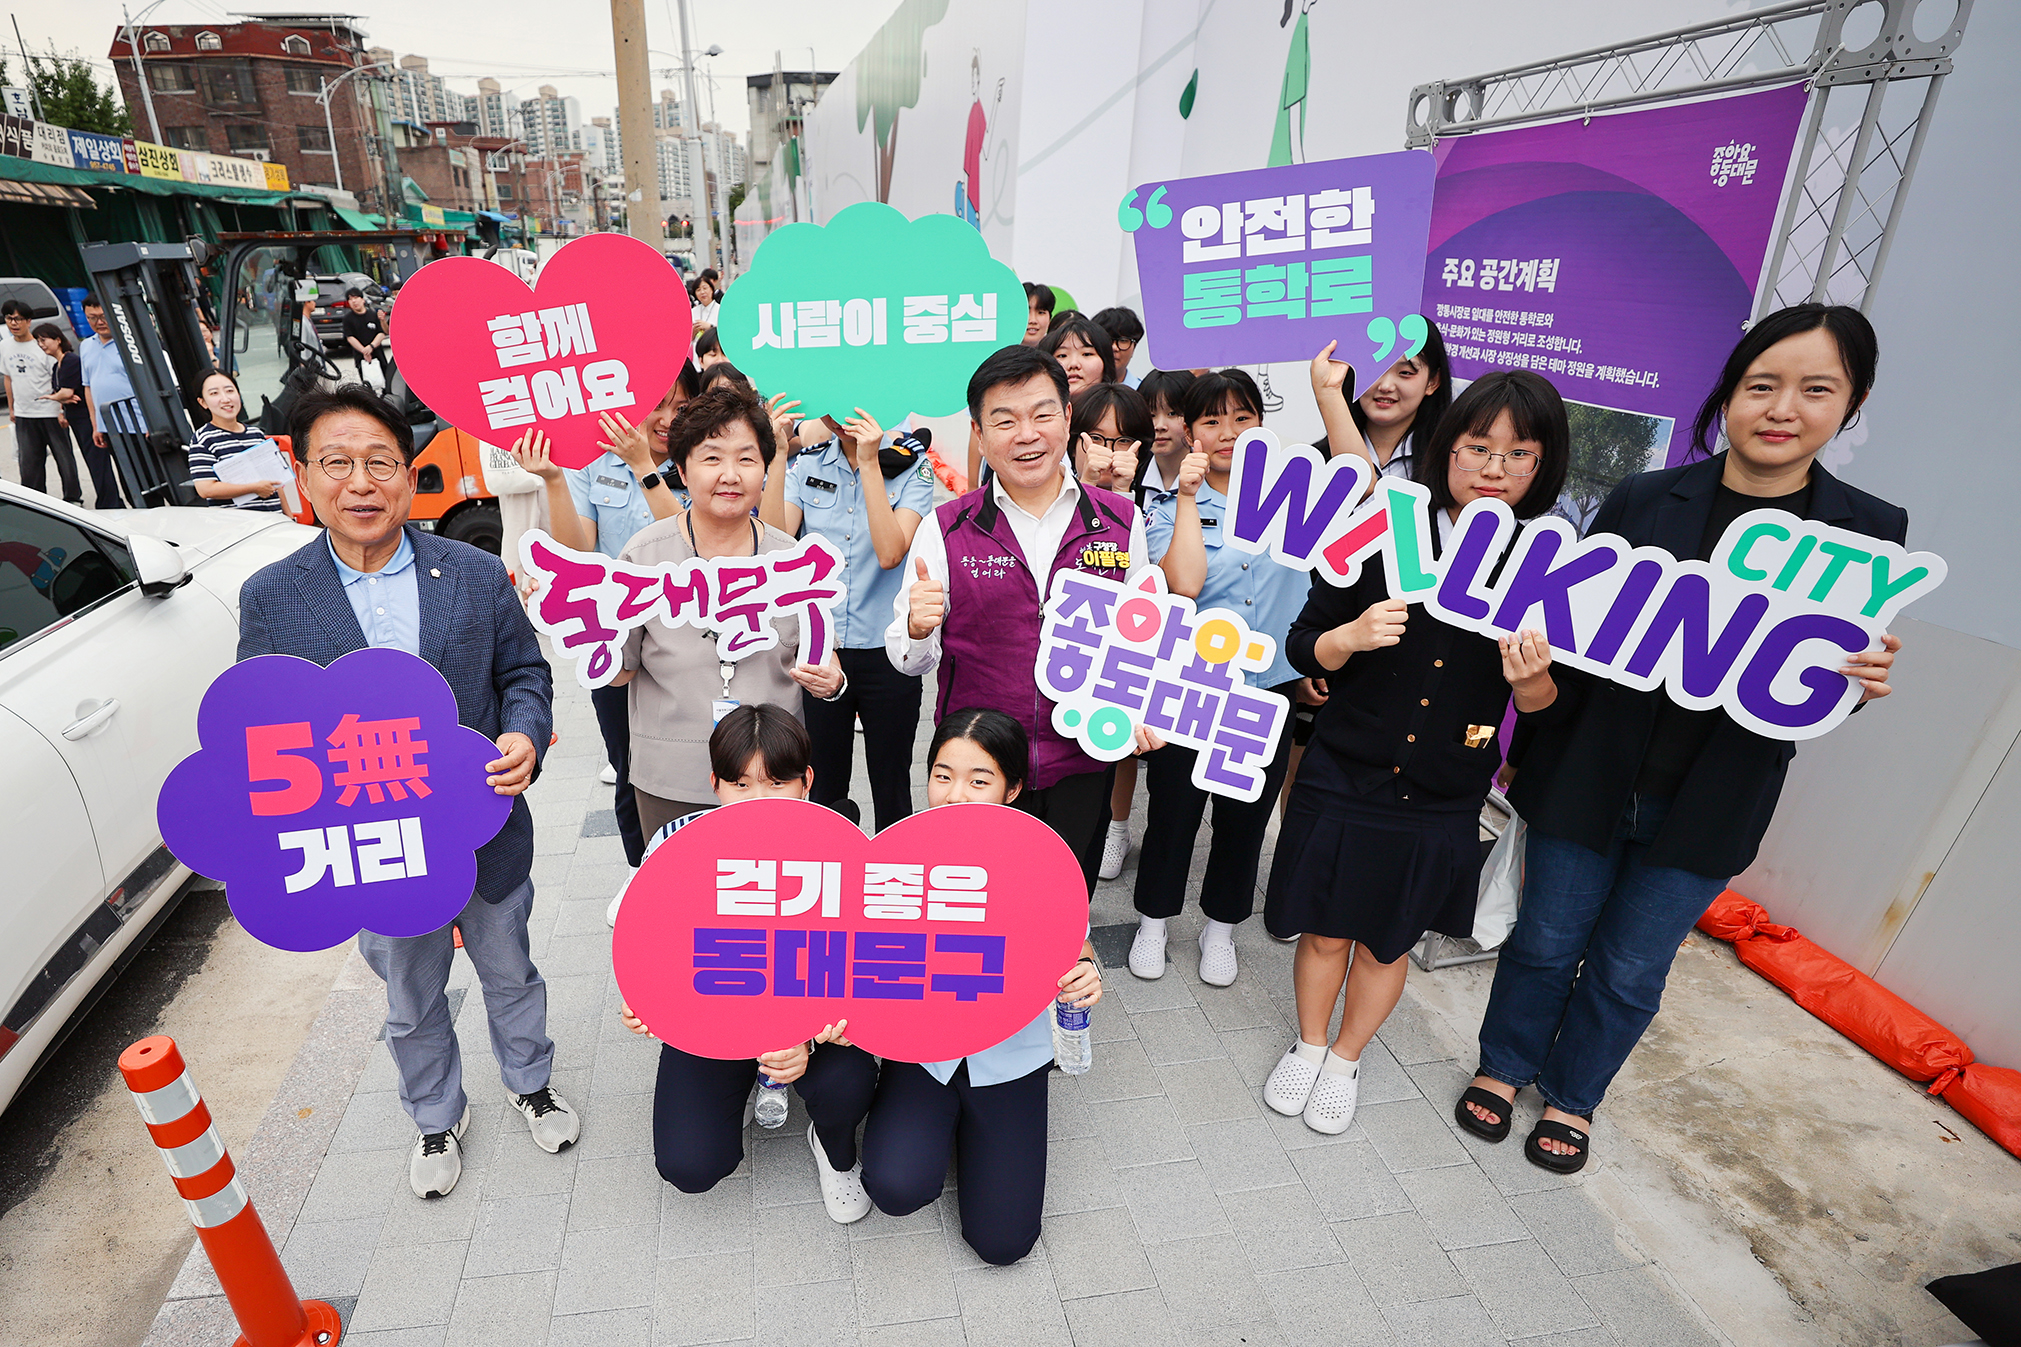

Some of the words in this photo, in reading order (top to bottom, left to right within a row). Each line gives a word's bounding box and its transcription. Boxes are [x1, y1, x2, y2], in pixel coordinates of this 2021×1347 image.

[71, 135, 124, 163] 제일상회
[138, 146, 180, 172] 삼진상회
[1713, 159, 1759, 188] 동대문
[1180, 186, 1375, 264] 안전한
[1182, 254, 1374, 329] 통학로
[1442, 258, 1476, 288] 주요
[1479, 258, 1560, 293] 공간계획
[111, 302, 144, 365] DOOSAN
[486, 302, 598, 369] 함께
[752, 297, 887, 350] 사람이
[903, 293, 997, 344] 중심
[1471, 307, 1494, 323] 일대를
[1494, 310, 1519, 326] 안전한
[1519, 311, 1554, 329] 통학로와
[1471, 326, 1486, 342] 있는
[1487, 329, 1511, 345] 정원형
[1511, 332, 1536, 348] 거리로
[1536, 334, 1583, 355] 조성합니다.
[478, 359, 636, 430] 걸어요
[1459, 345, 1481, 361] 개선과
[1480, 348, 1497, 364] 시장
[1497, 350, 1530, 369] 상징성을
[1530, 354, 1548, 371] 담은
[1548, 358, 1567, 375] 테마
[1566, 360, 1595, 379] 정원을
[1595, 365, 1660, 389] 계획했습니다.
[1083, 550, 1130, 568] 이필형
[1093, 541, 1118, 552] 구청장
[1727, 522, 1929, 618] CITY
[530, 541, 837, 679] 동대문구
[1232, 438, 1870, 728] WALKING
[1086, 644, 1278, 791] 동대문
[245, 713, 433, 817] 5無
[277, 816, 428, 894] 거리
[715, 858, 842, 919] 걷기
[862, 861, 989, 922] 좋은
[692, 928, 1006, 1002] 동대문구
